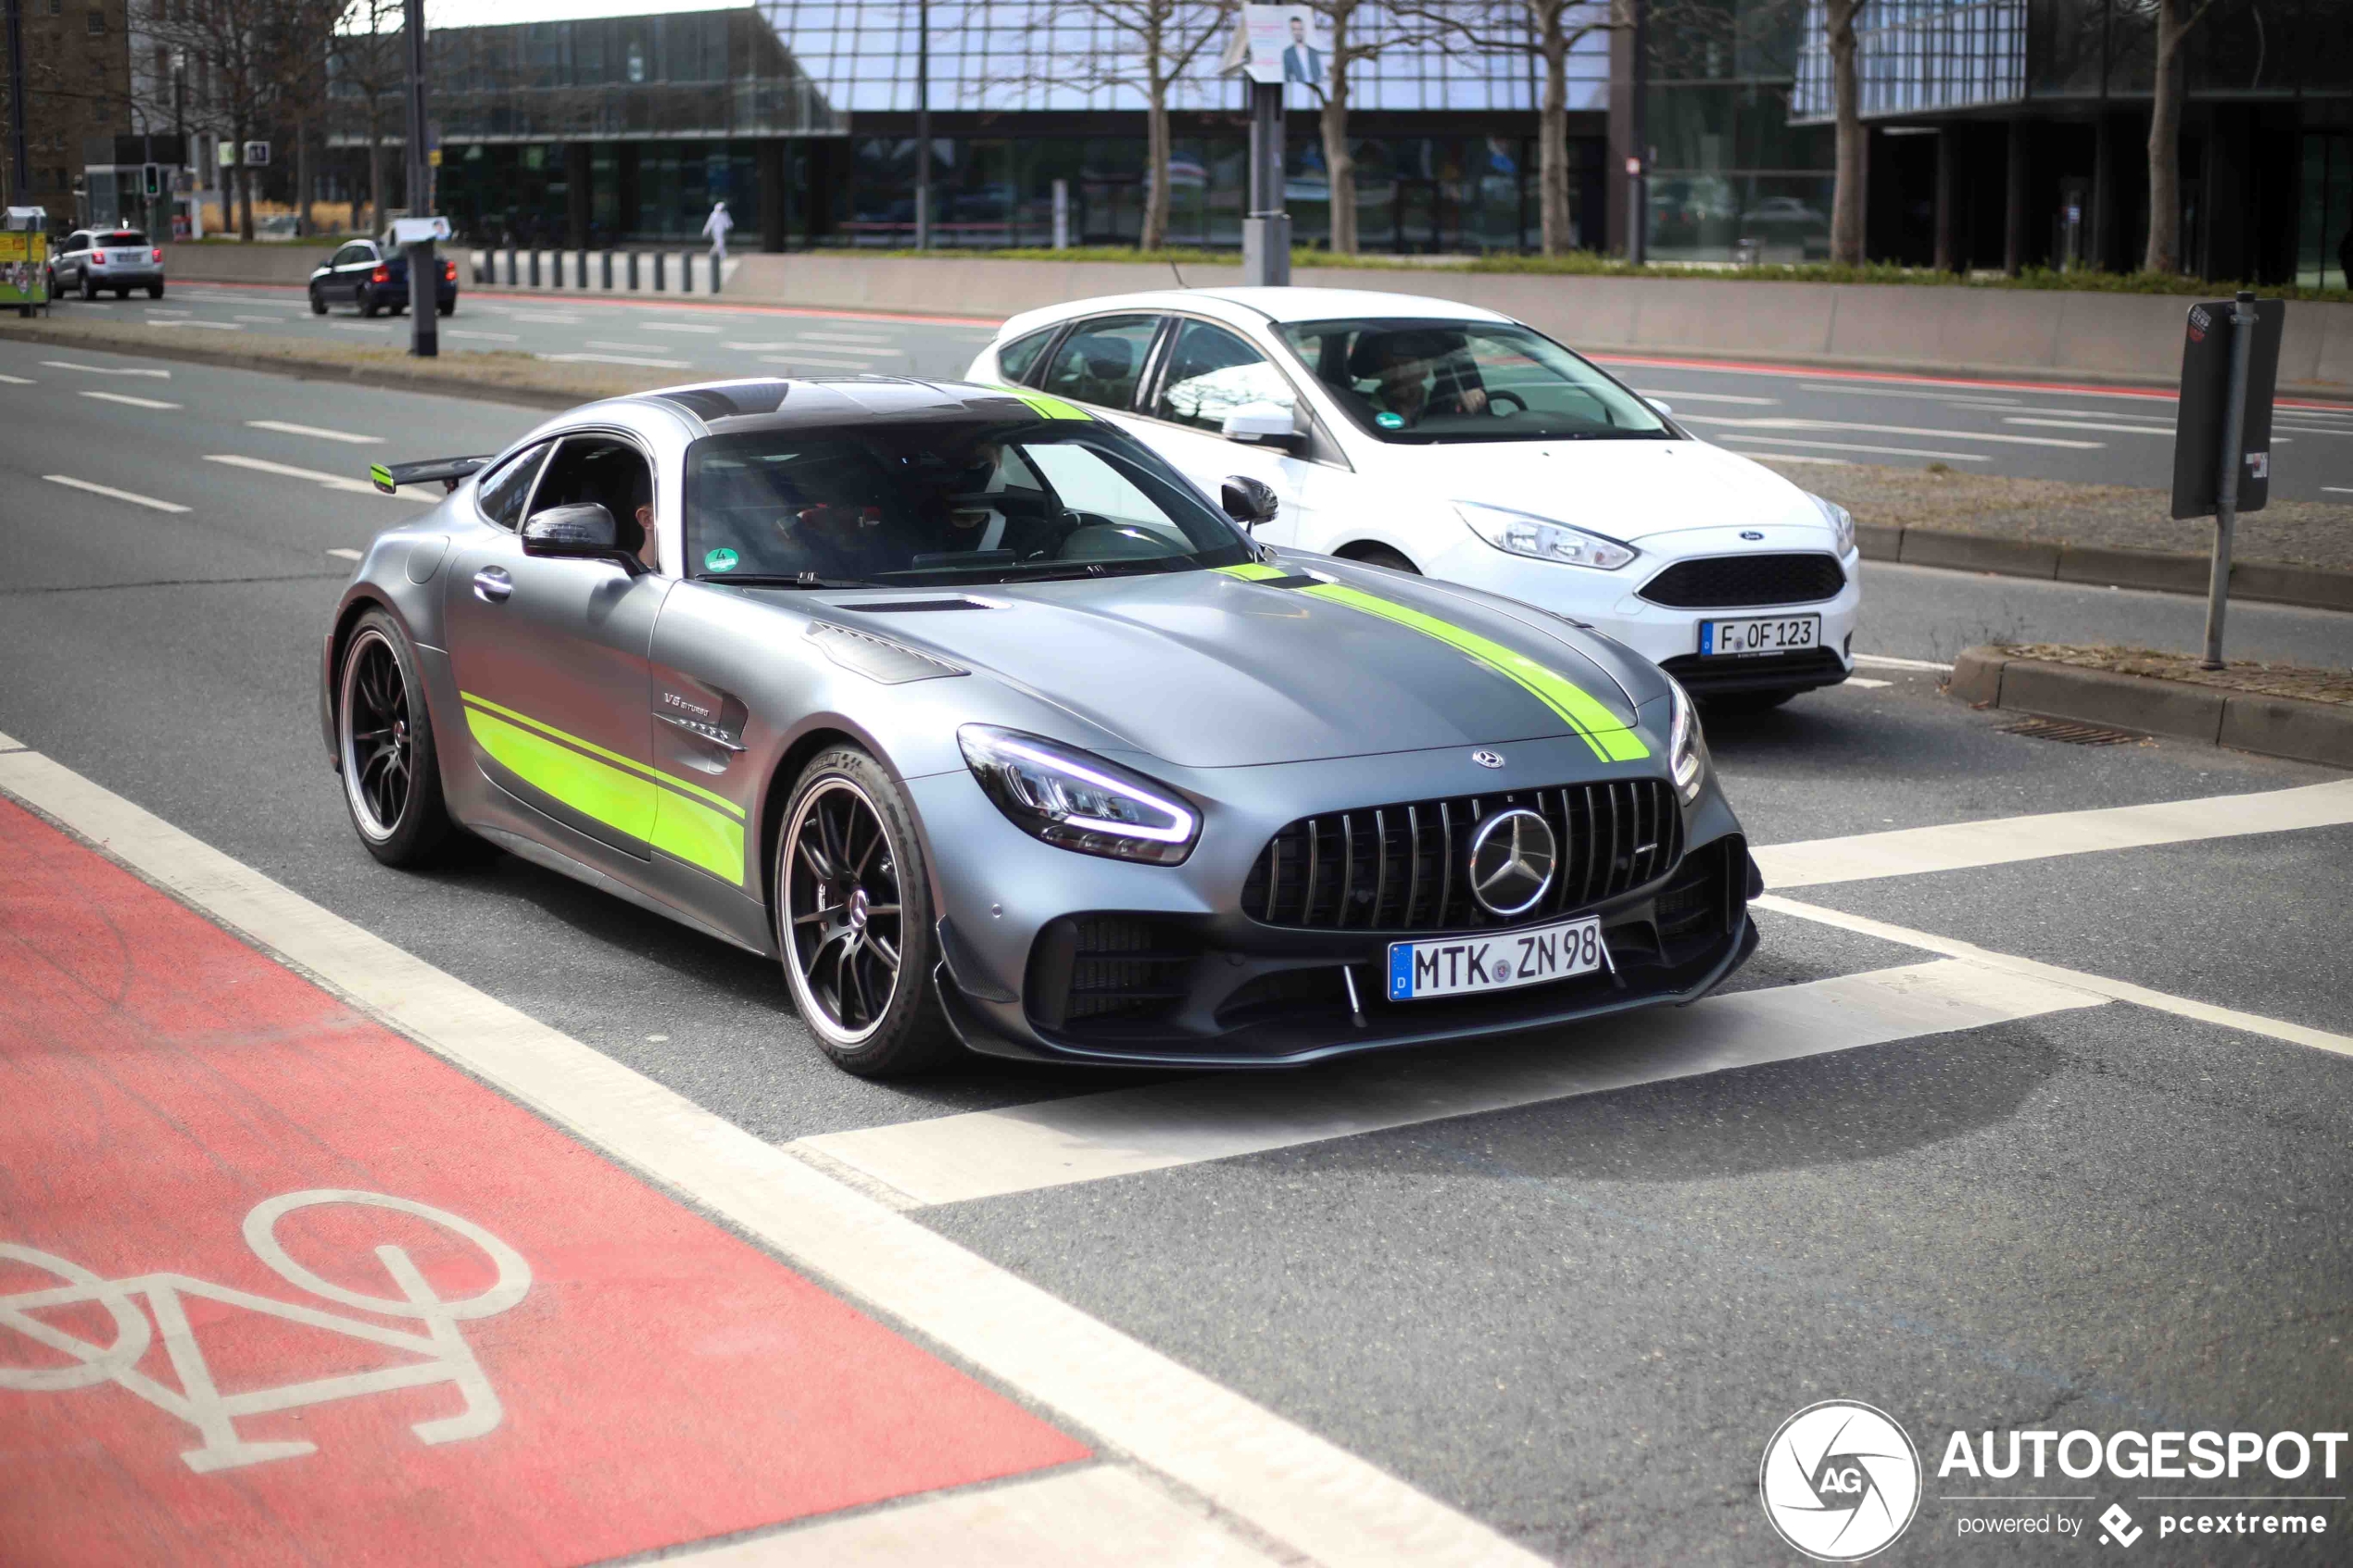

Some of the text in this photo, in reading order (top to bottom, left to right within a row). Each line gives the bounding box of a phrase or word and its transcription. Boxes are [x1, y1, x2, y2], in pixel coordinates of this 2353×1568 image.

[716, 548, 726, 560] 4
[1721, 625, 1734, 649] F
[1776, 621, 1812, 646] 123
[1704, 641, 1710, 649] D
[1415, 925, 1597, 990] MTK ZN 98
[1397, 977, 1406, 989] D
